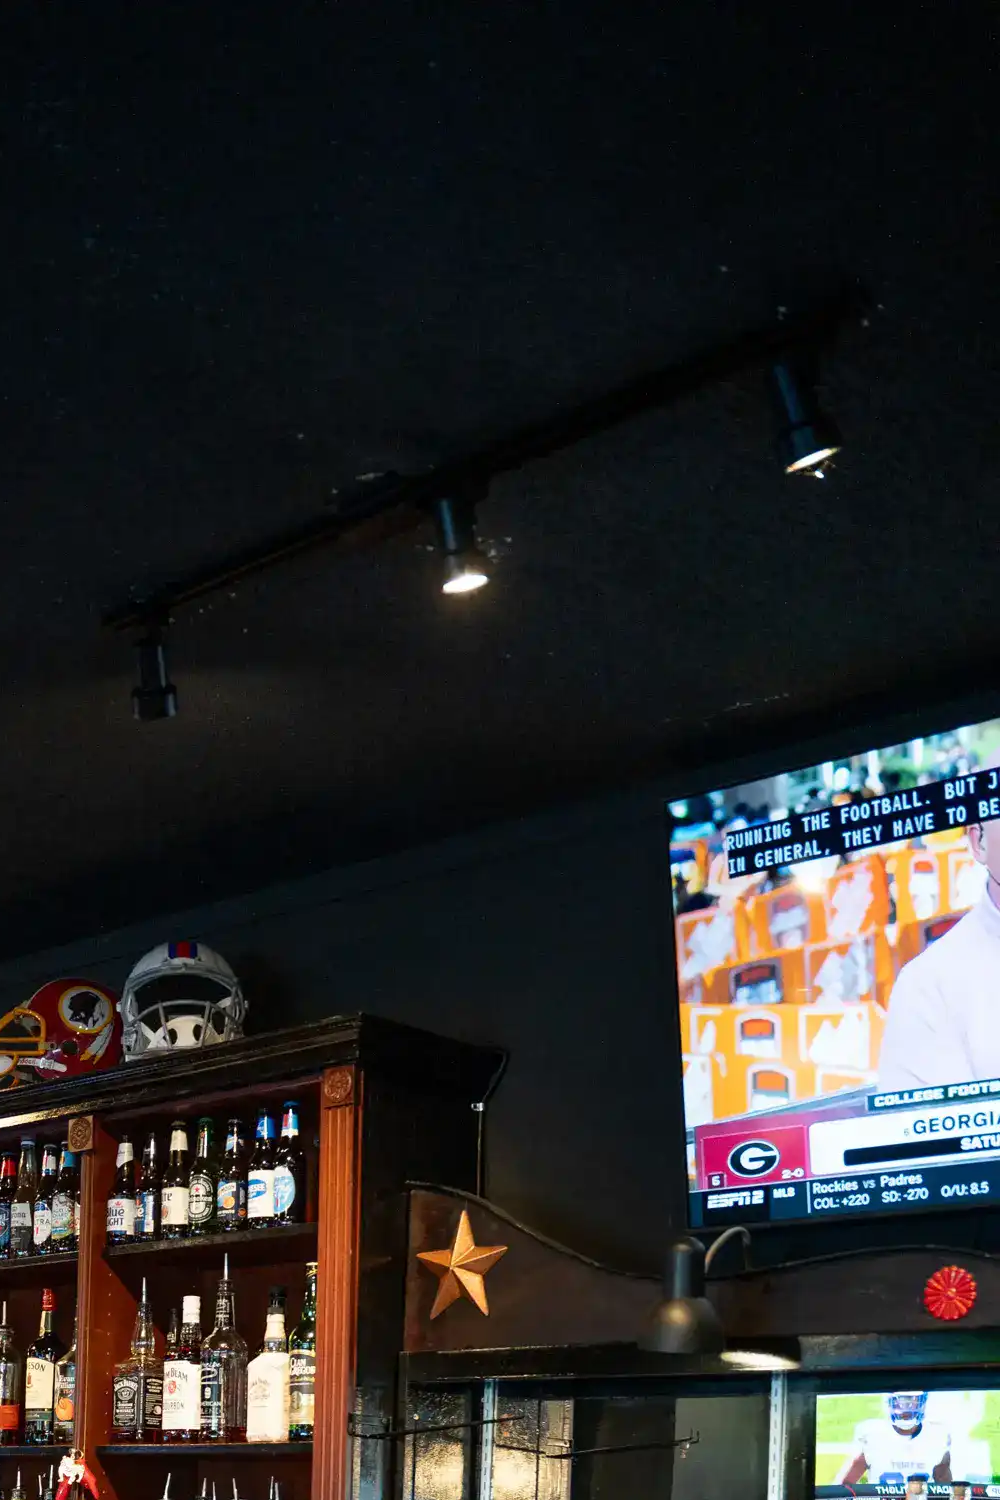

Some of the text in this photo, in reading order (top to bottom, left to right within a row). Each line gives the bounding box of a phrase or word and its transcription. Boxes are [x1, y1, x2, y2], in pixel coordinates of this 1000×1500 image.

[726, 822, 792, 850] RUNNING
[802, 813, 831, 833] THE
[841, 792, 931, 825] FOOTBALL.
[945, 778, 977, 799] BUT
[728, 797, 1000, 875] IN GENERAL, THEY HAVE TO BE
[874, 1088, 944, 1108] COLLEGE
[781, 1168, 804, 1180] 2-0
[813, 1174, 923, 1194] Rockies vs Padres
[707, 1189, 764, 1209] ESPN2
[773, 1187, 796, 1199] MLB
[813, 1197, 839, 1210] COL:
[841, 1194, 870, 1206] +220
[882, 1190, 902, 1203] SD:
[903, 1187, 929, 1200] -270
[107, 1207, 125, 1217] lue
